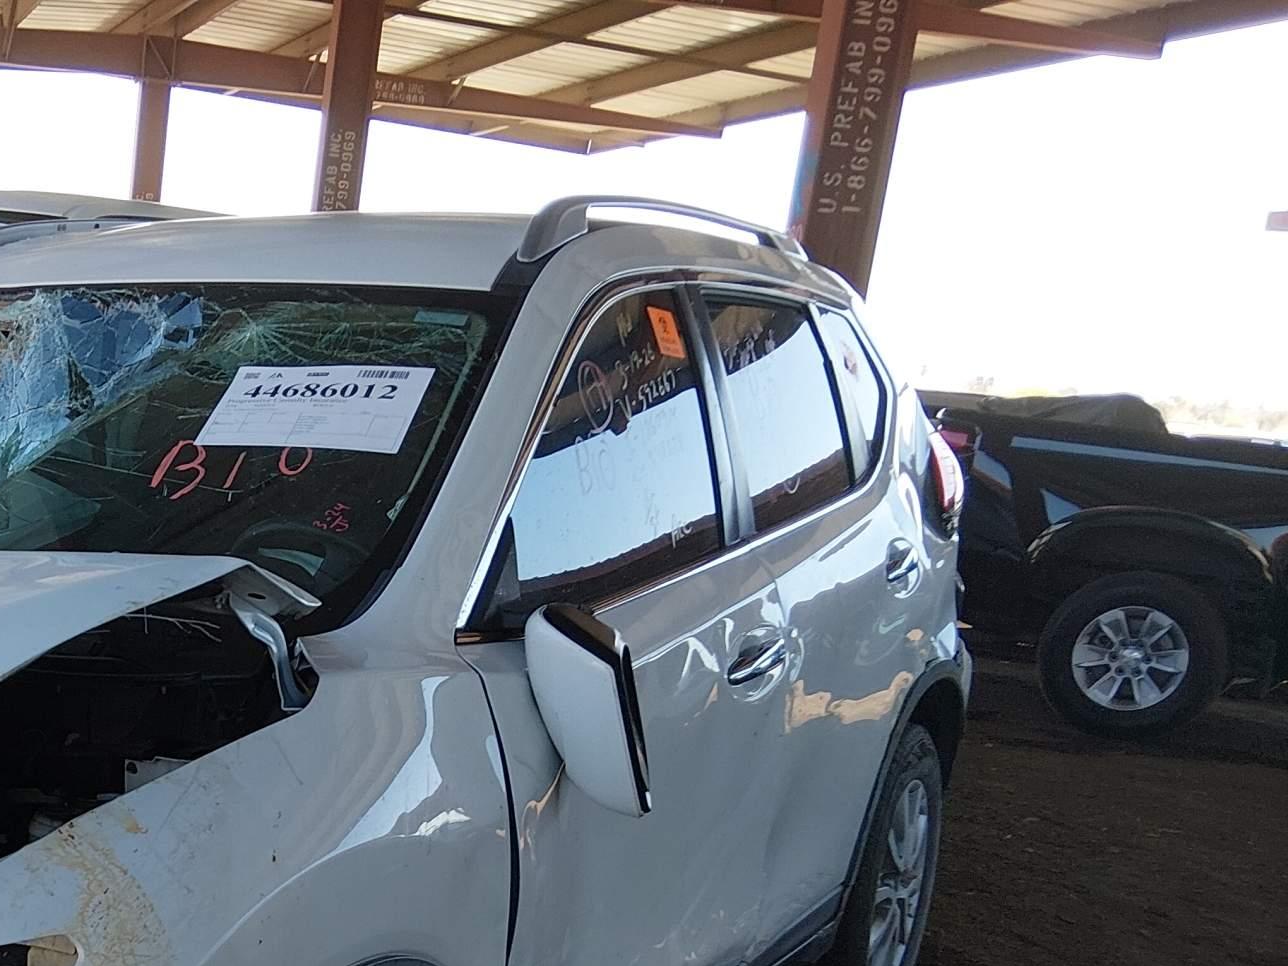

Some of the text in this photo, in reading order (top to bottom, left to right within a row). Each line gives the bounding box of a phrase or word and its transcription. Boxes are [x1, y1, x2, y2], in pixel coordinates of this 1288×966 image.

[817, 0, 875, 214] U.S. PREFAB IN
[841, 0, 899, 213] 1-866-799-096
[322, 128, 343, 211] REFAB INC.
[335, 131, 357, 210] 799-0969
[243, 383, 399, 400] 44686012
